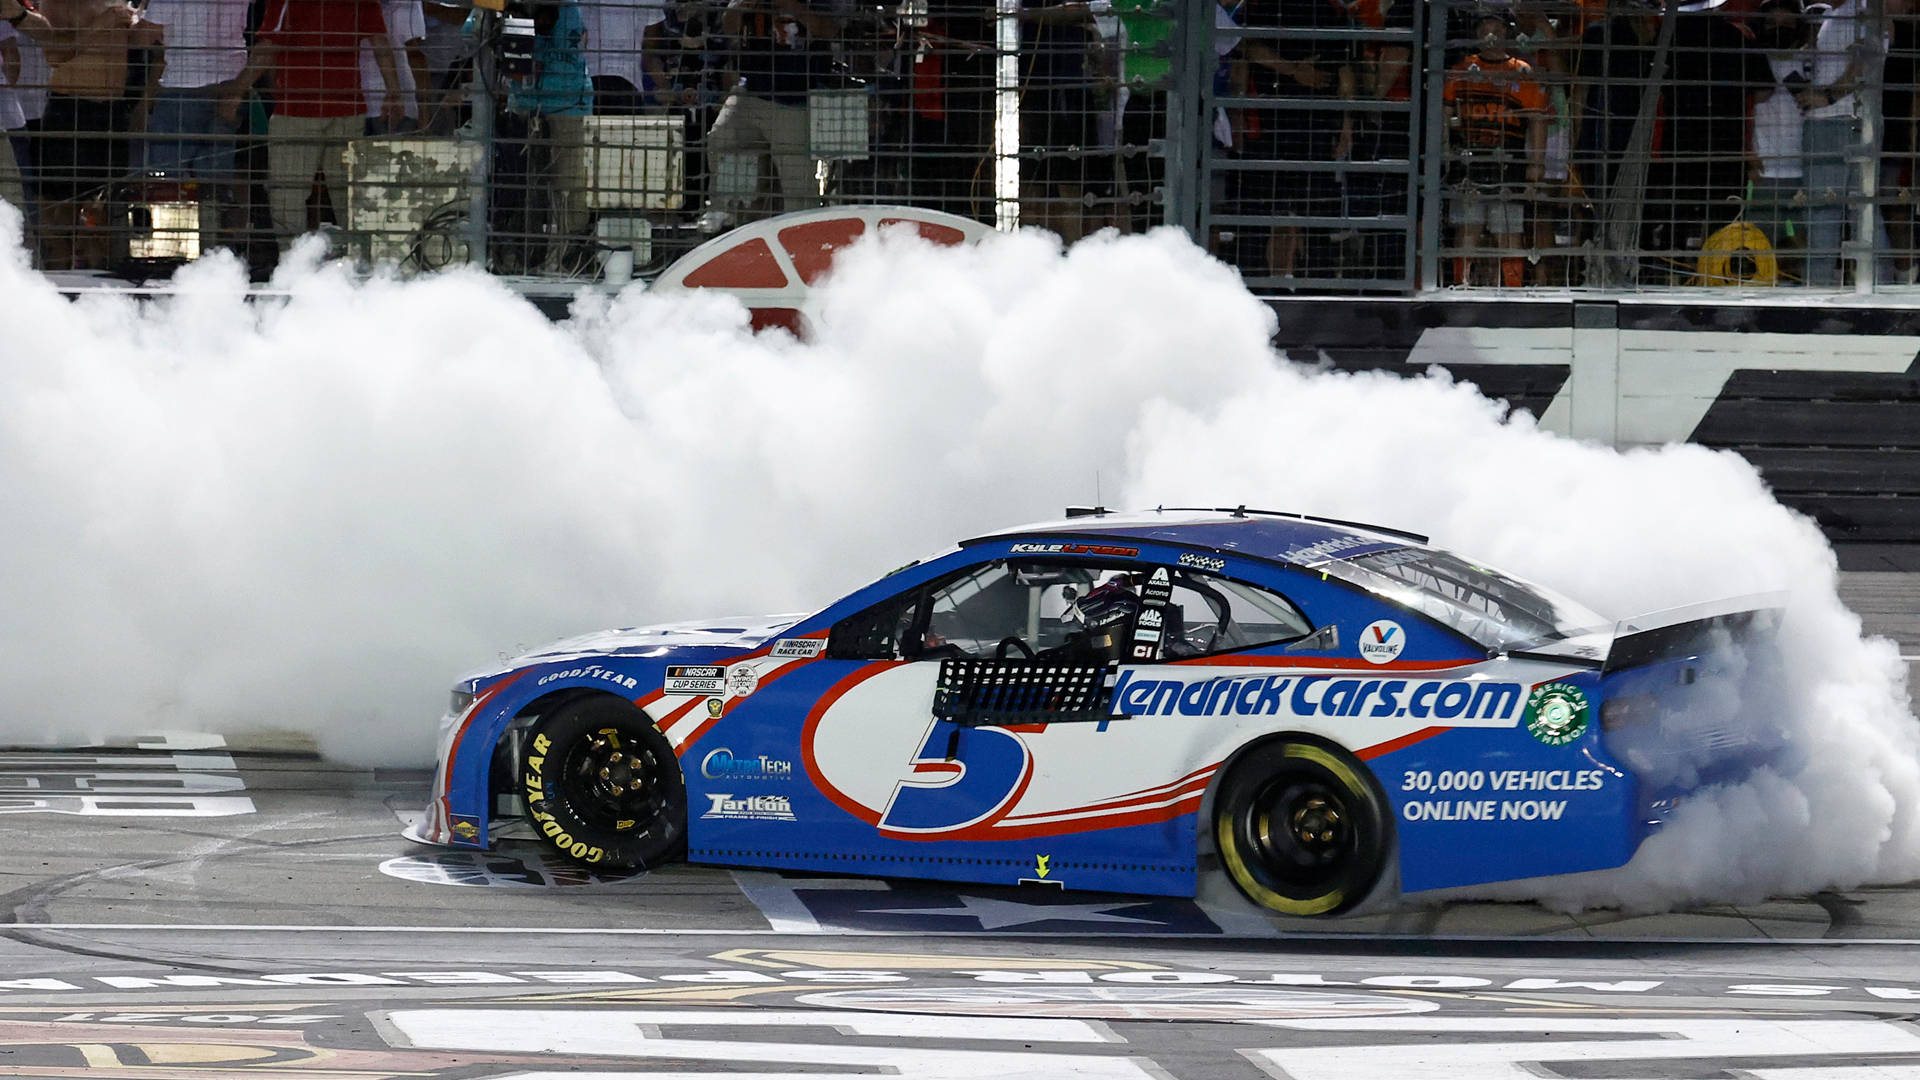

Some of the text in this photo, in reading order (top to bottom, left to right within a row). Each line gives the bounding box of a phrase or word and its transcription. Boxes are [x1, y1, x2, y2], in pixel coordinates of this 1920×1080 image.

[776, 648, 813, 656] RACE CAR
[789, 640, 817, 648] NASCAR
[685, 667, 717, 677] NASCAR
[672, 680, 717, 689] CUP SERIES
[877, 715, 1030, 834] 5
[1401, 770, 1605, 794] 30,000 VEHICLES
[704, 792, 791, 814] Tarlton
[1403, 800, 1568, 821] ONLINE NOW
[952, 969, 1665, 994] MOTOR
